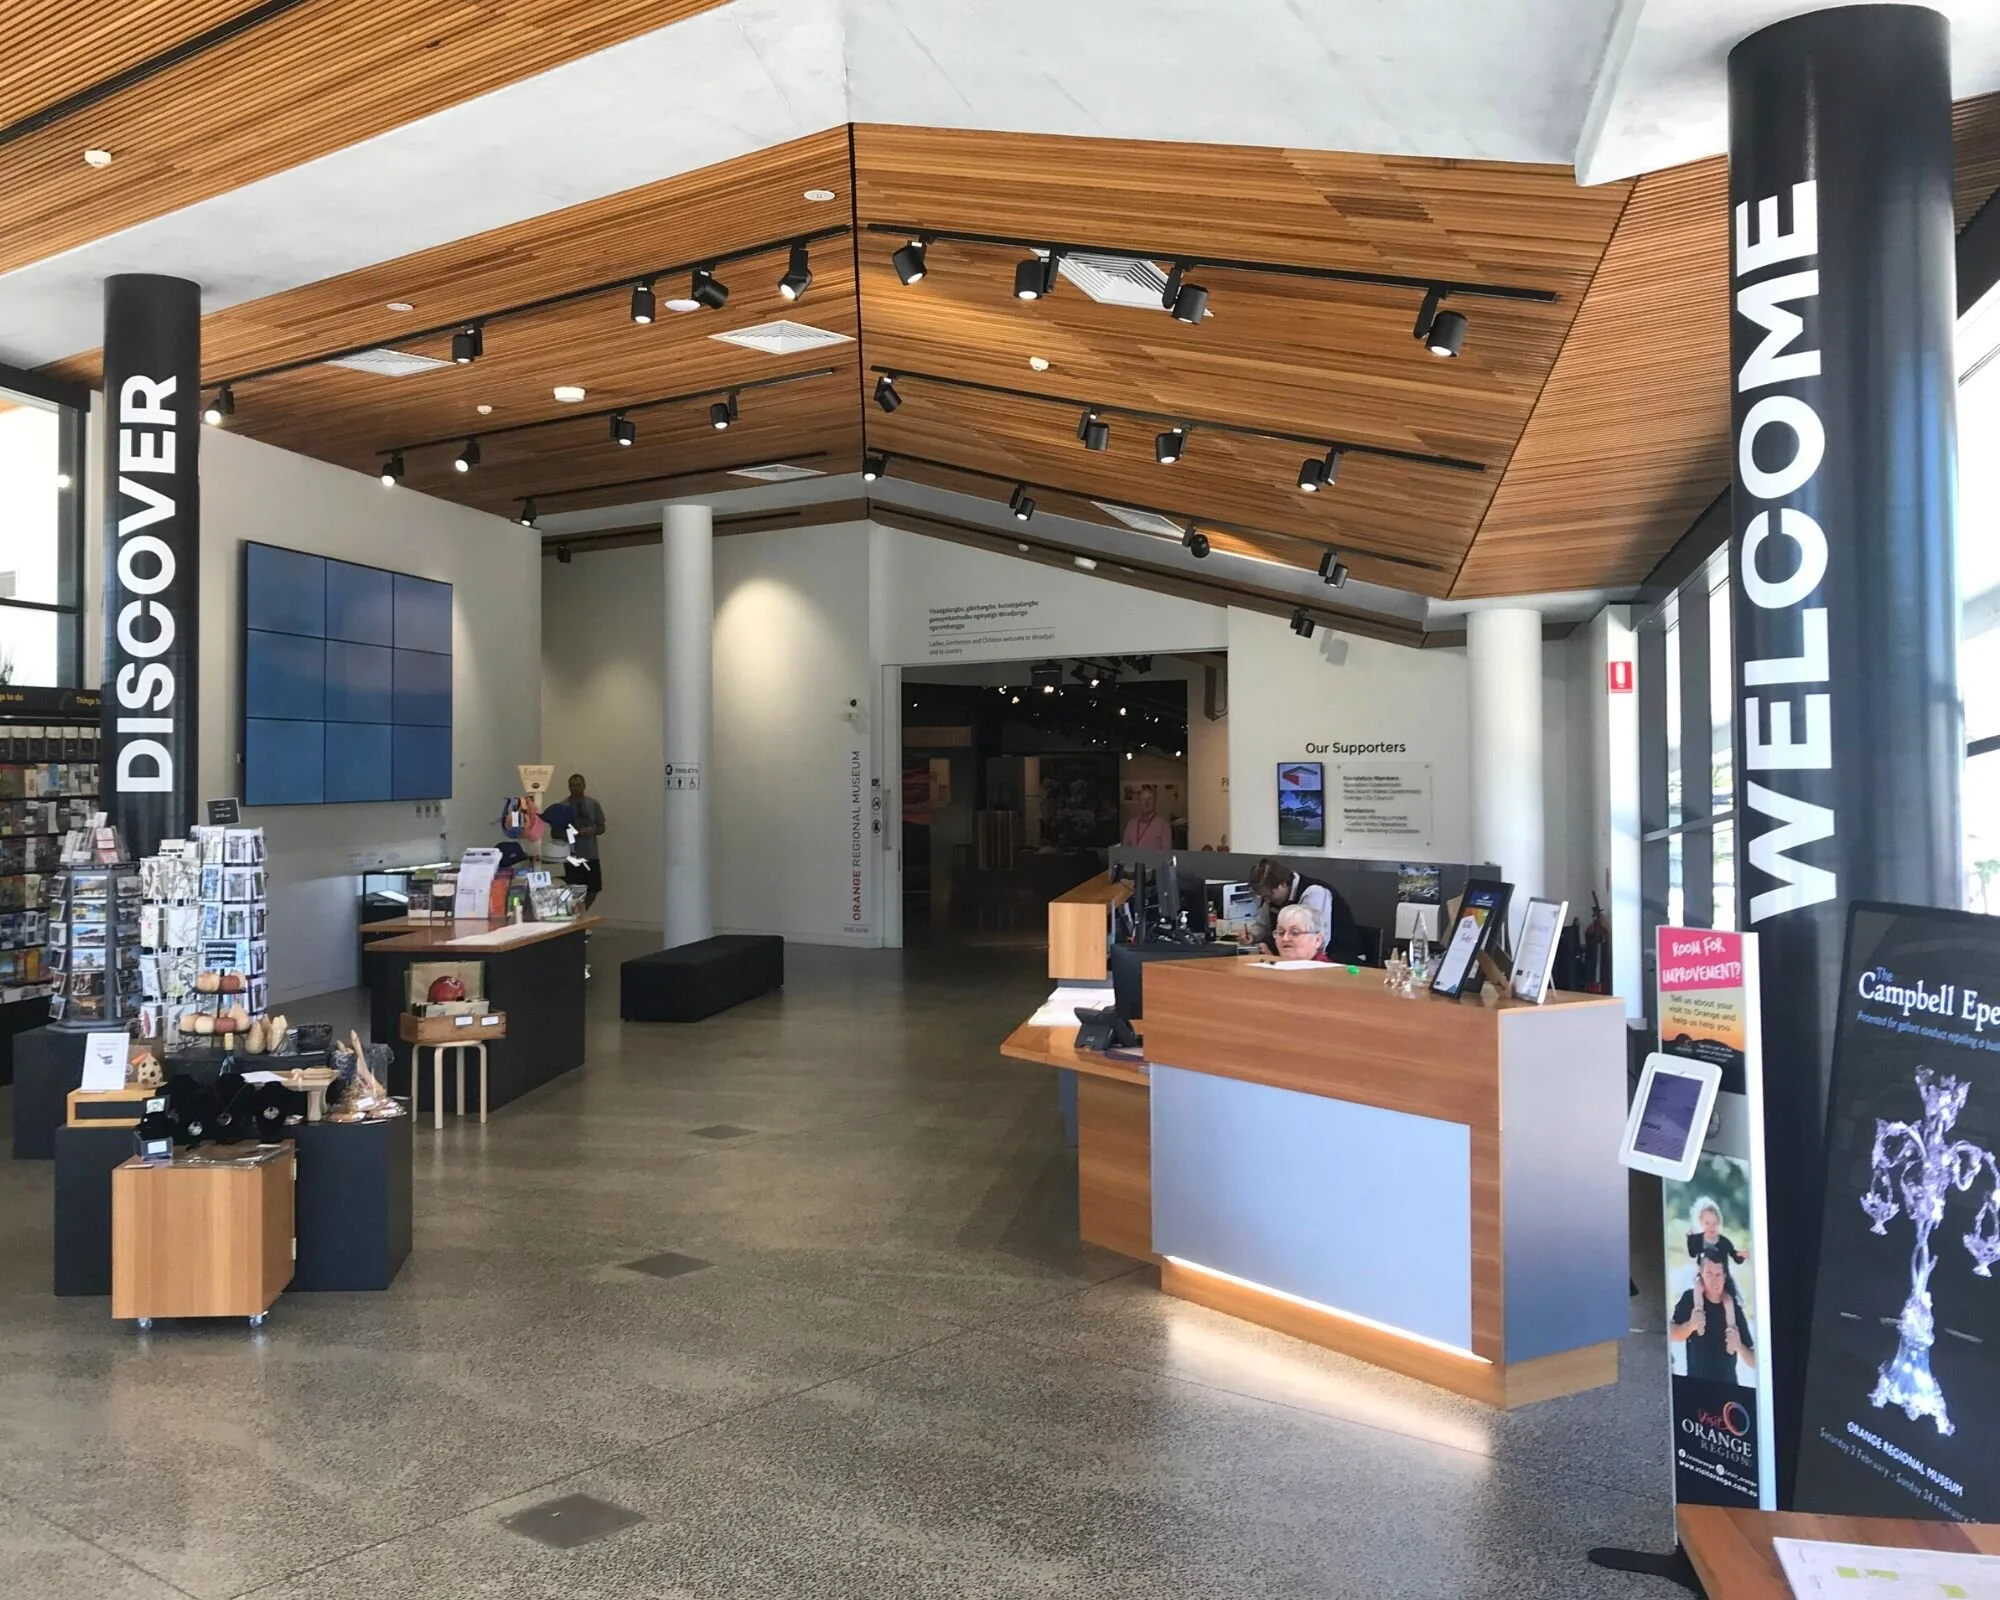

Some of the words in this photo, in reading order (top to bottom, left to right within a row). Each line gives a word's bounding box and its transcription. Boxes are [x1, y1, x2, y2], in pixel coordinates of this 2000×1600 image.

[1736, 179, 1838, 924] WELCOME
[116, 375, 177, 792] DISCOVER
[15, 693, 24, 701] do
[76, 696, 95, 706] Things
[1305, 742, 1329, 754] Our
[1332, 741, 1407, 756] Supporters
[851, 751, 860, 804] MUSEUM
[852, 806, 861, 867] REGIONAL
[852, 870, 862, 921] ORANGE
[1672, 940, 1702, 958] ROOM
[1703, 936, 1726, 956] FOR
[1662, 961, 1741, 984] IMPROVEMENT?
[1875, 966, 1895, 982] The
[1670, 994, 1682, 1004] Tell
[1694, 998, 1715, 1008] about
[1716, 1002, 1734, 1011] your
[1858, 972, 1955, 1016] Campbell
[1668, 1006, 1683, 1014] visit
[1684, 1007, 1692, 1015] to
[1694, 1008, 1721, 1020] Orange
[1722, 1013, 1736, 1022] and
[1672, 1016, 1688, 1026] help
[1699, 1020, 1715, 1030] help
[1856, 1010, 1888, 1027] Presented
[1887, 1016, 1899, 1029] for
[1978, 1040, 1985, 1049] a
[1696, 1408, 1722, 1429] Visit
[1682, 1418, 1753, 1458] ORANGE
[1701, 1439, 1750, 1466] REGION
[1819, 1426, 1849, 1455] Saturday
[1850, 1445, 1856, 1456] 2
[1856, 1448, 1890, 1478] February
[1896, 1472, 1922, 1498] Sunday
[1934, 1495, 1969, 1524] February
[1847, 1420, 1882, 1450] ORANGE
[1882, 1441, 1926, 1476] REGIONAL
[1926, 1467, 1964, 1498] MUSEUM
[1679, 1460, 1758, 1498] www.visitorange.com.au
